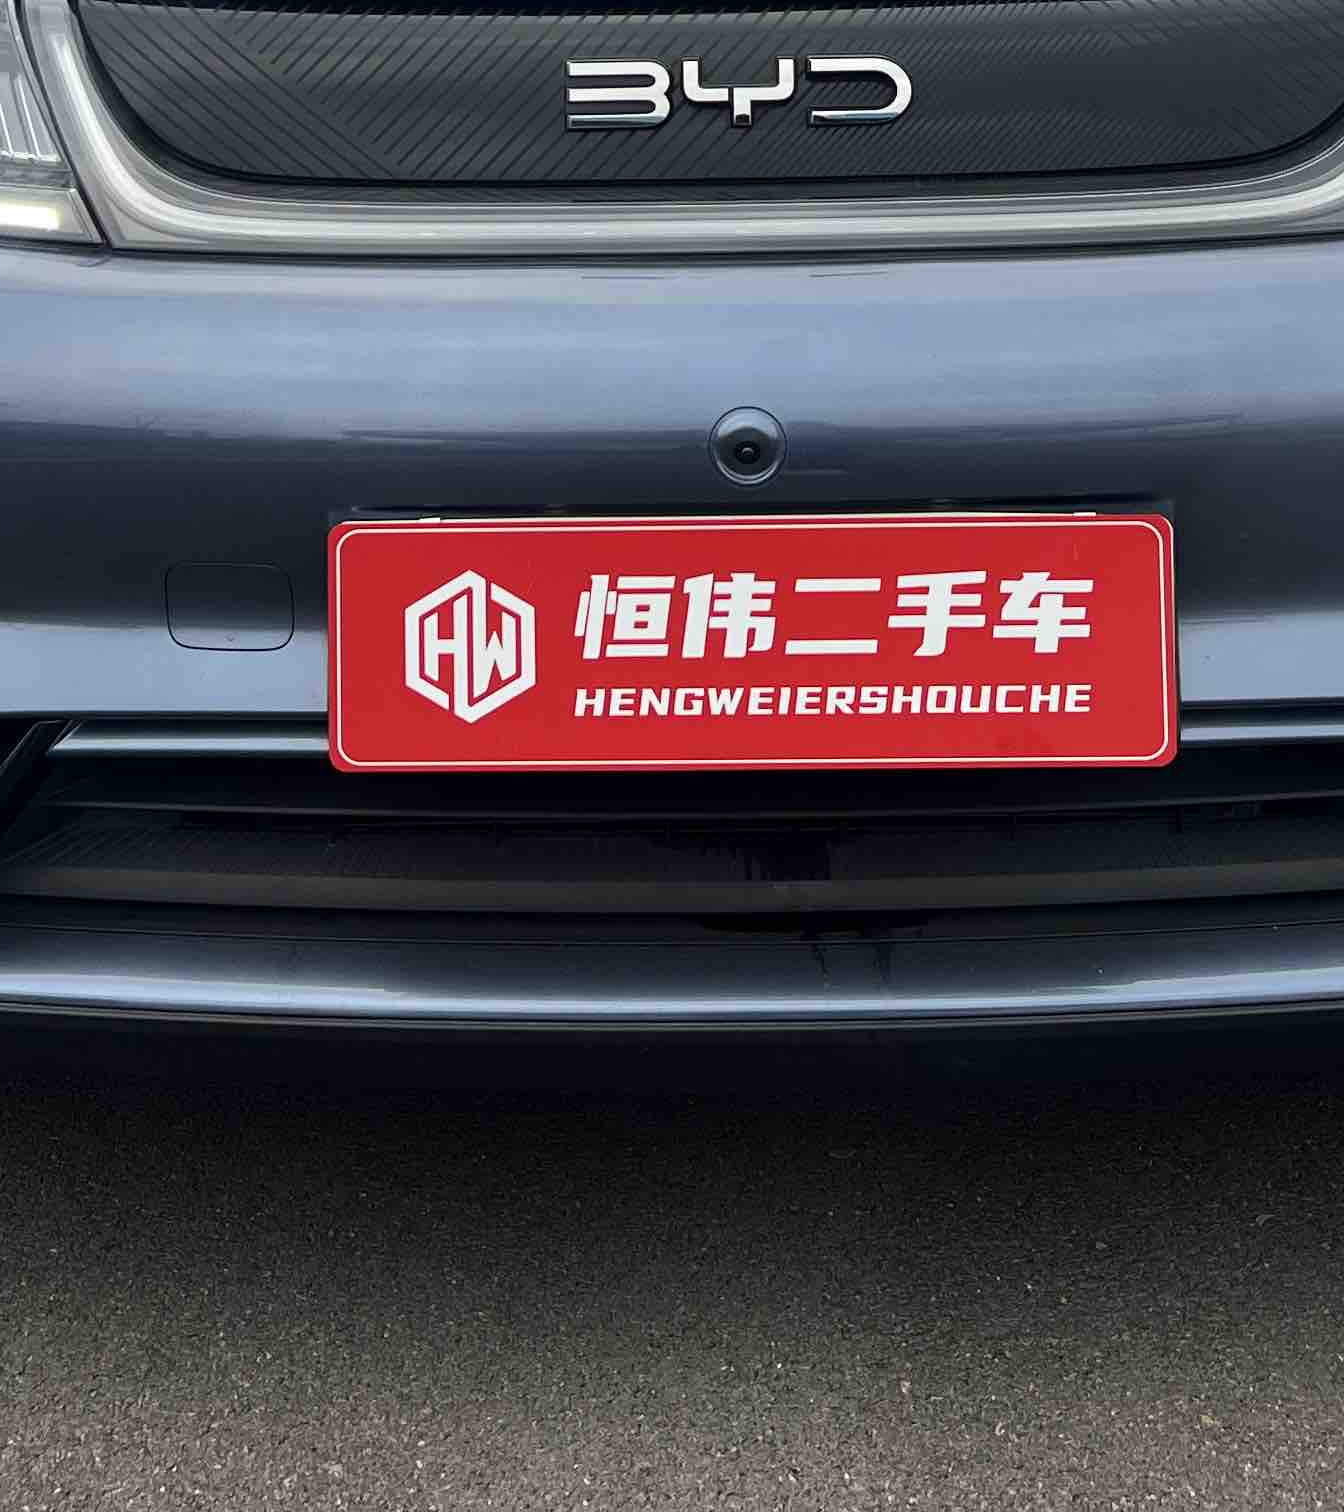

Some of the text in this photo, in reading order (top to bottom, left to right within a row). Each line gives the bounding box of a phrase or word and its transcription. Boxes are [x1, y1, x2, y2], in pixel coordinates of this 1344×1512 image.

[566, 55, 913, 130] BYD
[574, 570, 1094, 660] 恒伟二手车
[574, 684, 1092, 718] HENGWEIERSHOUCHE
